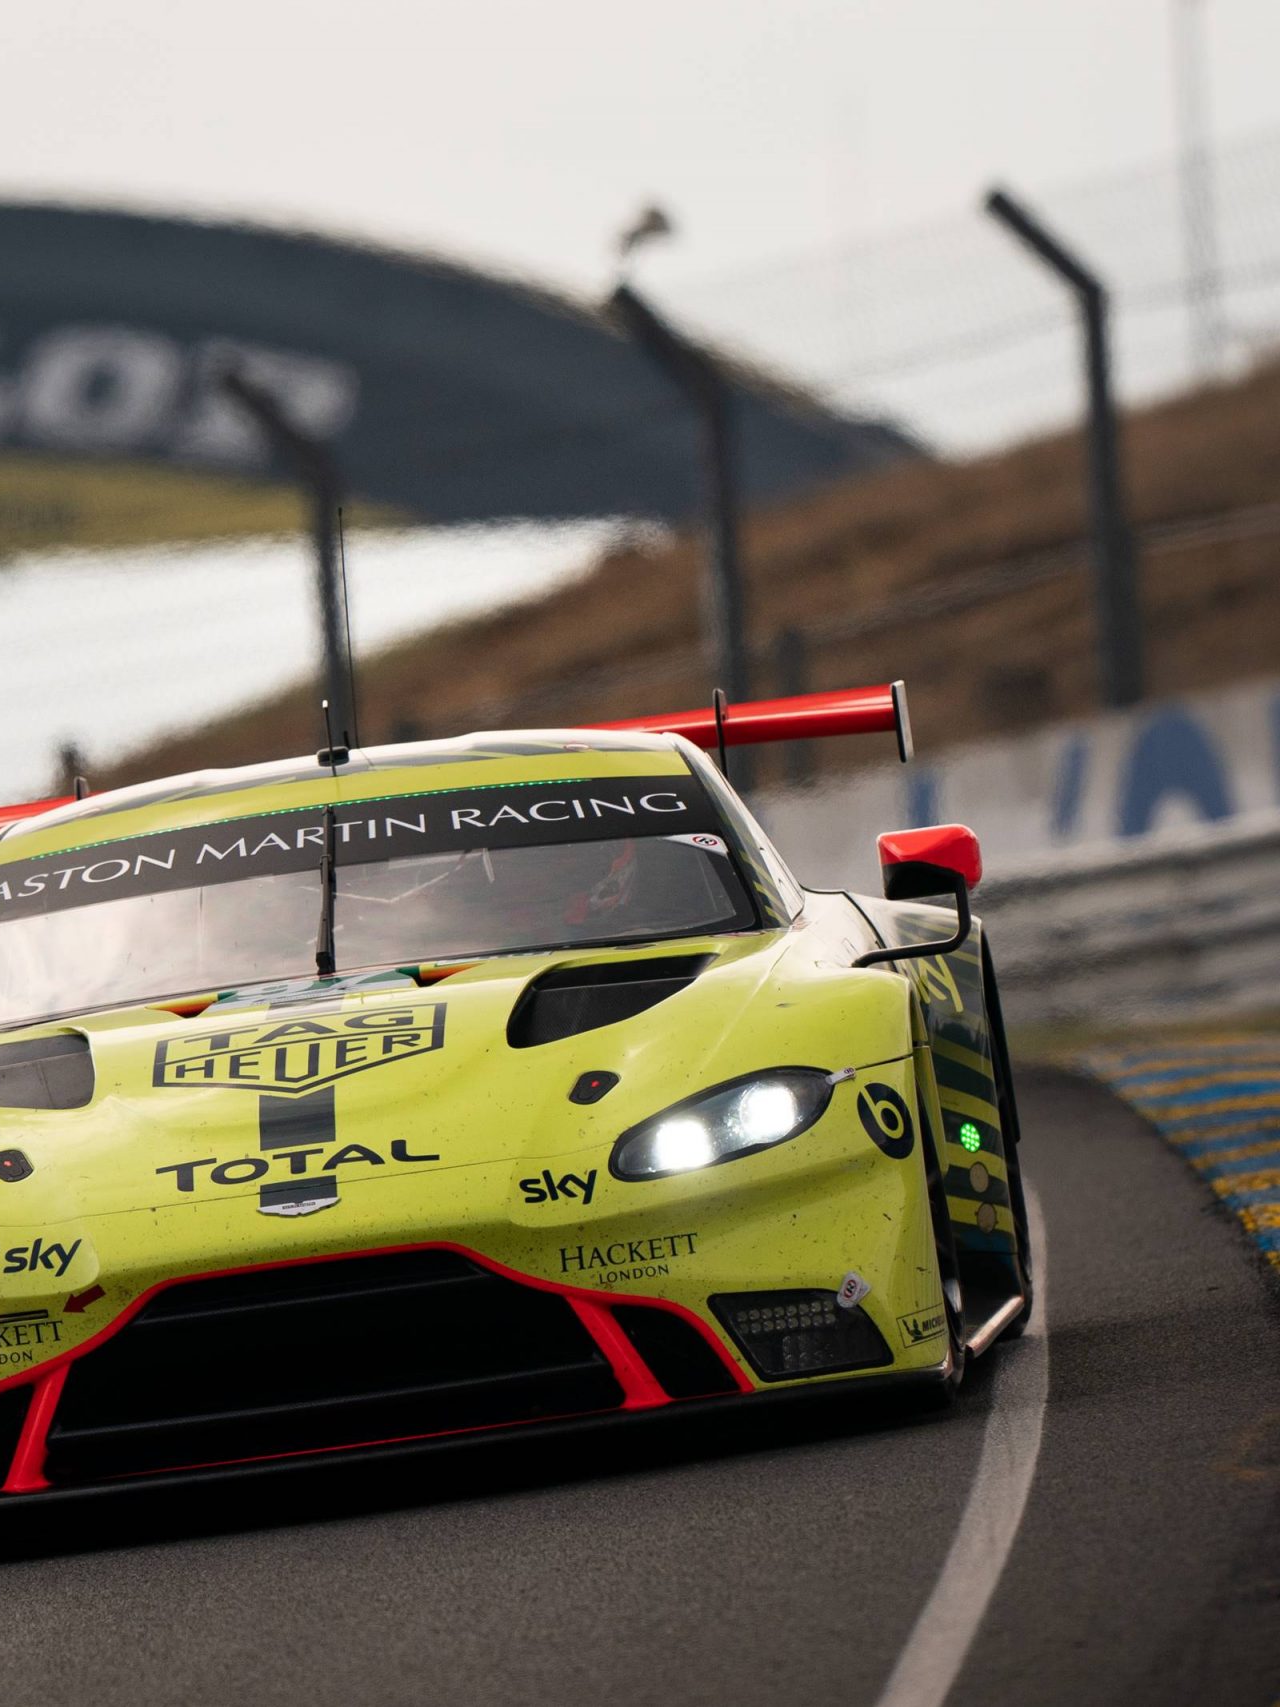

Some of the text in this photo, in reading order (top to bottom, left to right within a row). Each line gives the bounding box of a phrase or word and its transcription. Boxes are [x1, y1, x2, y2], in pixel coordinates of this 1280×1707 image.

[195, 814, 426, 864] MARTIN
[451, 792, 687, 830] RACING
[183, 1010, 413, 1050] TAG
[175, 1033, 421, 1083] HEUER
[155, 1139, 440, 1192] TOTAL
[519, 1169, 597, 1205] sky
[4, 1238, 82, 1277] sky
[559, 1232, 698, 1273] HACKETT
[599, 1263, 669, 1285] LONDON
